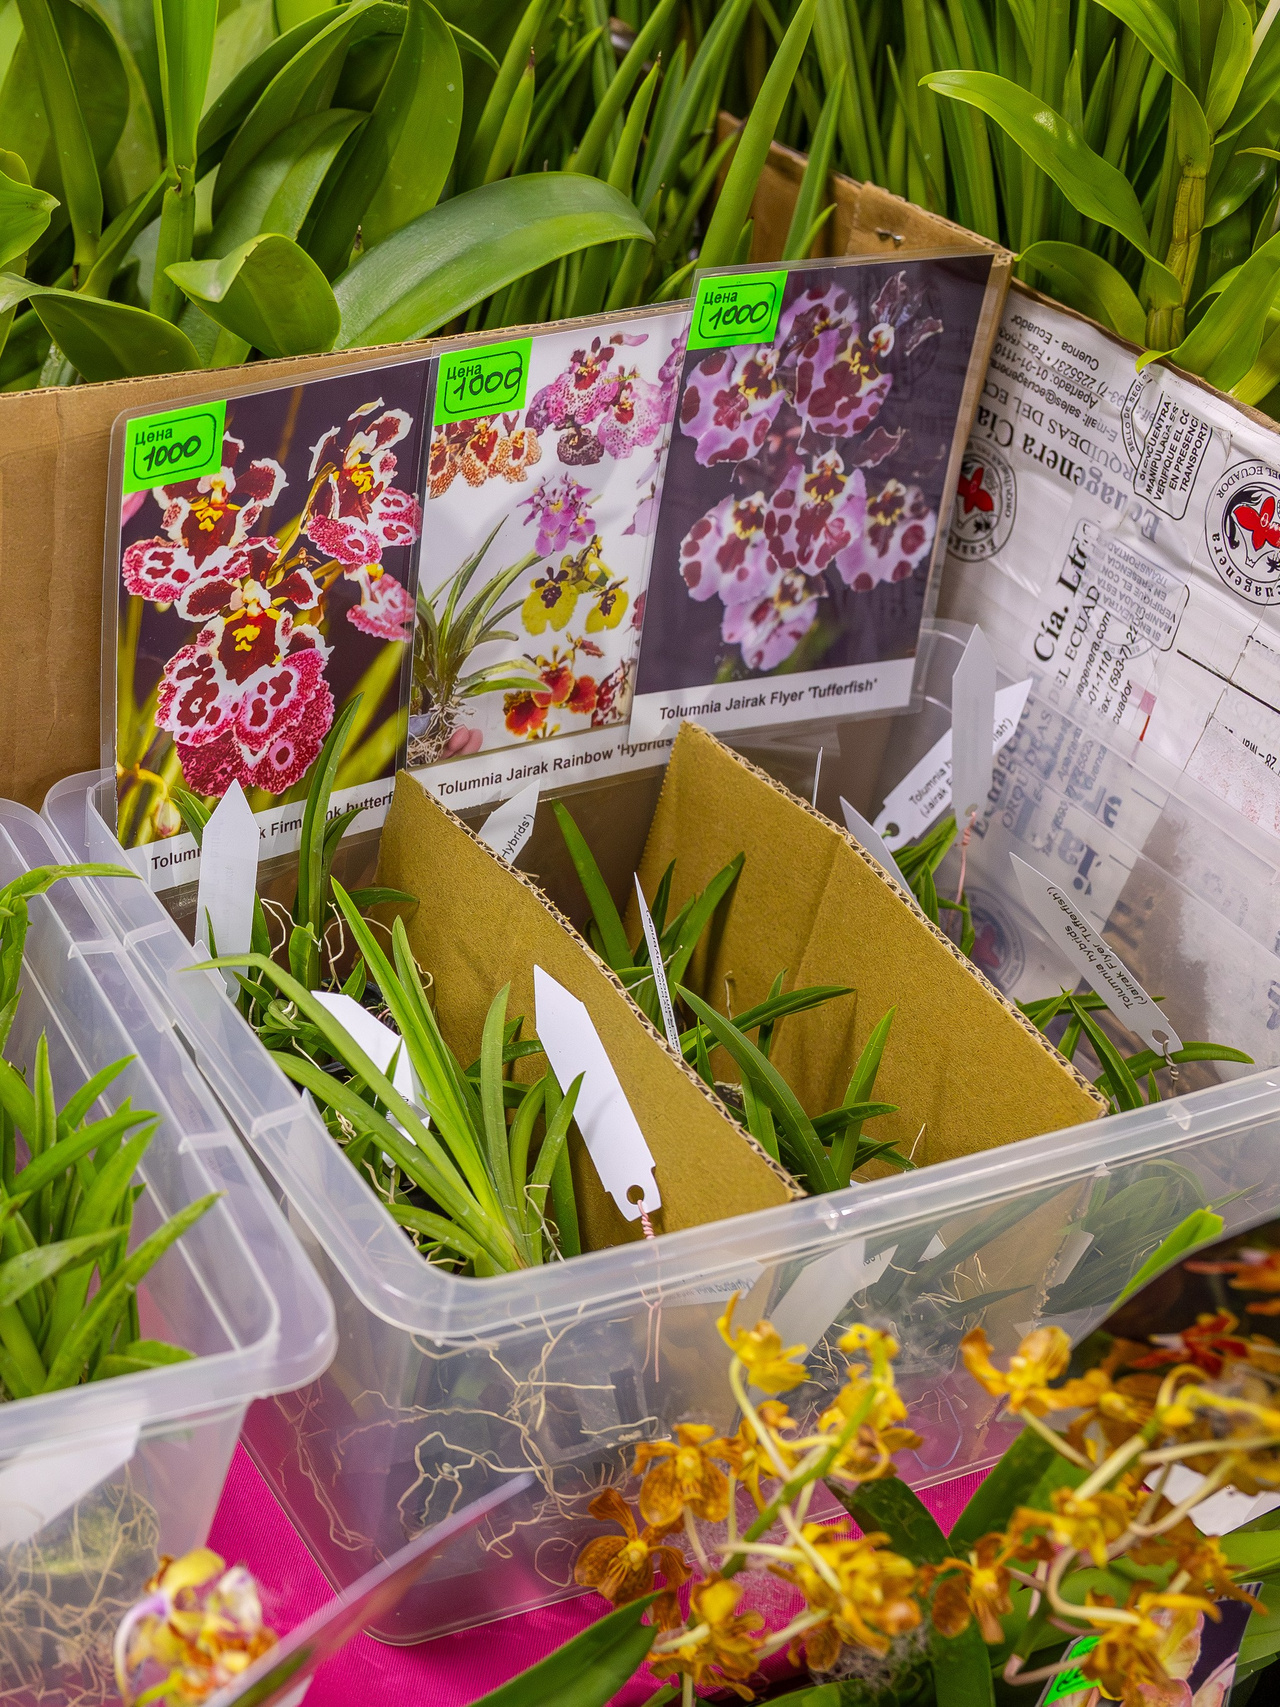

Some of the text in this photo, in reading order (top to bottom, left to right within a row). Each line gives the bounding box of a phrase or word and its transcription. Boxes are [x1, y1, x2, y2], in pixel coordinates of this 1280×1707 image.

[704, 292, 738, 305] Цена
[709, 301, 768, 330] 1000
[1009, 312, 1054, 344] Ecuador
[447, 364, 482, 380] Цена
[1059, 339, 1101, 371] Cuenca
[453, 367, 522, 400] 1000
[1047, 371, 1100, 410] Apartado:
[1050, 356, 1097, 390] 2255237
[1008, 395, 1046, 426] DEL
[1080, 411, 1119, 442] E-mail:
[1124, 405, 1136, 451] SELLO DE
[135, 428, 172, 446] Цена
[143, 436, 201, 472] 1000
[1172, 415, 1200, 472] PRESENCI
[1142, 422, 1173, 493] MANIPULADA
[1152, 426, 1183, 500] VERIFIQUE EL
[1013, 432, 1167, 542] Ecuagenera
[1167, 473, 1179, 489] EN
[1216, 466, 1264, 499] ECUADOR
[1212, 532, 1280, 598] uagenera
[1094, 575, 1118, 596] ESTA
[1119, 577, 1134, 590] EL
[1152, 587, 1168, 600] EN
[1131, 587, 1178, 623] VERIFIQUE
[1032, 606, 1069, 661] Cía.
[1063, 585, 1102, 661] ECUAD
[1150, 628, 1162, 640] SI
[1107, 644, 1133, 691] (593-7)
[660, 678, 878, 720] Tolumnia Jairak Flyer 'Tufferfish'
[1111, 679, 1134, 724] cuador
[438, 772, 502, 796] Tolumnia
[506, 761, 548, 782] Jairak
[554, 748, 613, 771] Rainbow
[908, 766, 946, 804] Tolumnia
[918, 786, 947, 818] (Jairak
[271, 818, 302, 836] Firm
[1063, 924, 1096, 963] hybrids
[1091, 941, 1116, 970] Flyer
[1095, 962, 1133, 1009] Tolumnia
[1115, 970, 1146, 1006] (Jairak
